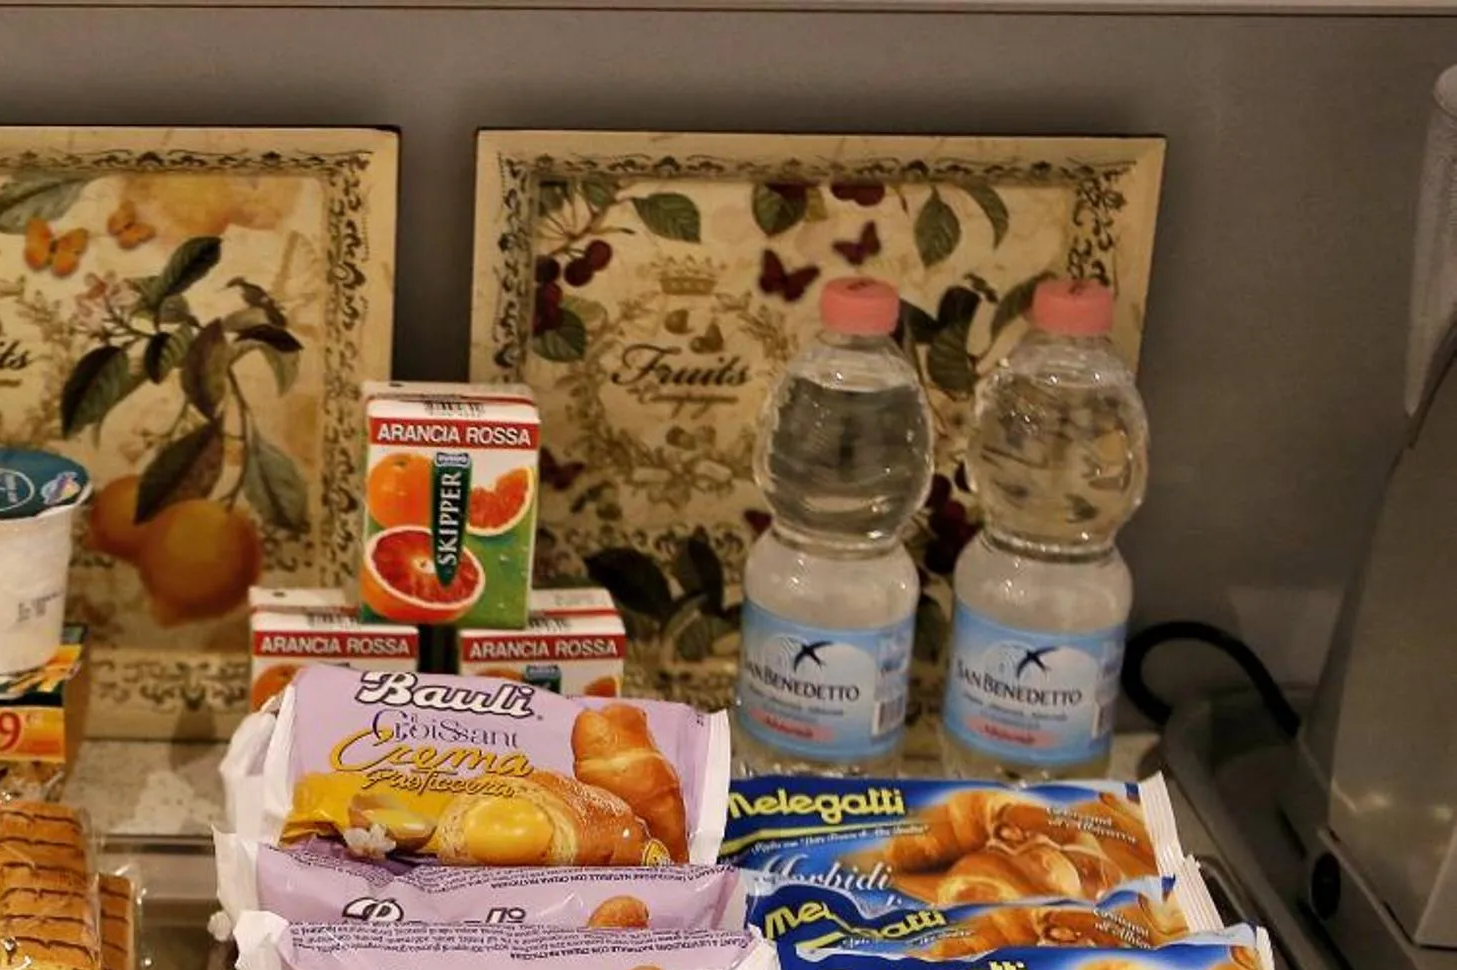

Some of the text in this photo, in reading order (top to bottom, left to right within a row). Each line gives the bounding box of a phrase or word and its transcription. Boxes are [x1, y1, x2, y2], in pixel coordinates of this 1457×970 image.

[610, 343, 753, 387] Fruits
[376, 422, 532, 447] ARANCIA ROSSA
[437, 471, 463, 567] SKIPPER
[260, 635, 412, 657] ARANCIA ROSSA
[469, 637, 618, 660] ARANCIA ROSSA
[354, 670, 536, 719] Bauli
[763, 665, 861, 701] BENEDETTO
[956, 658, 1083, 707] SAN BENEDETTO
[329, 726, 535, 778] Crema
